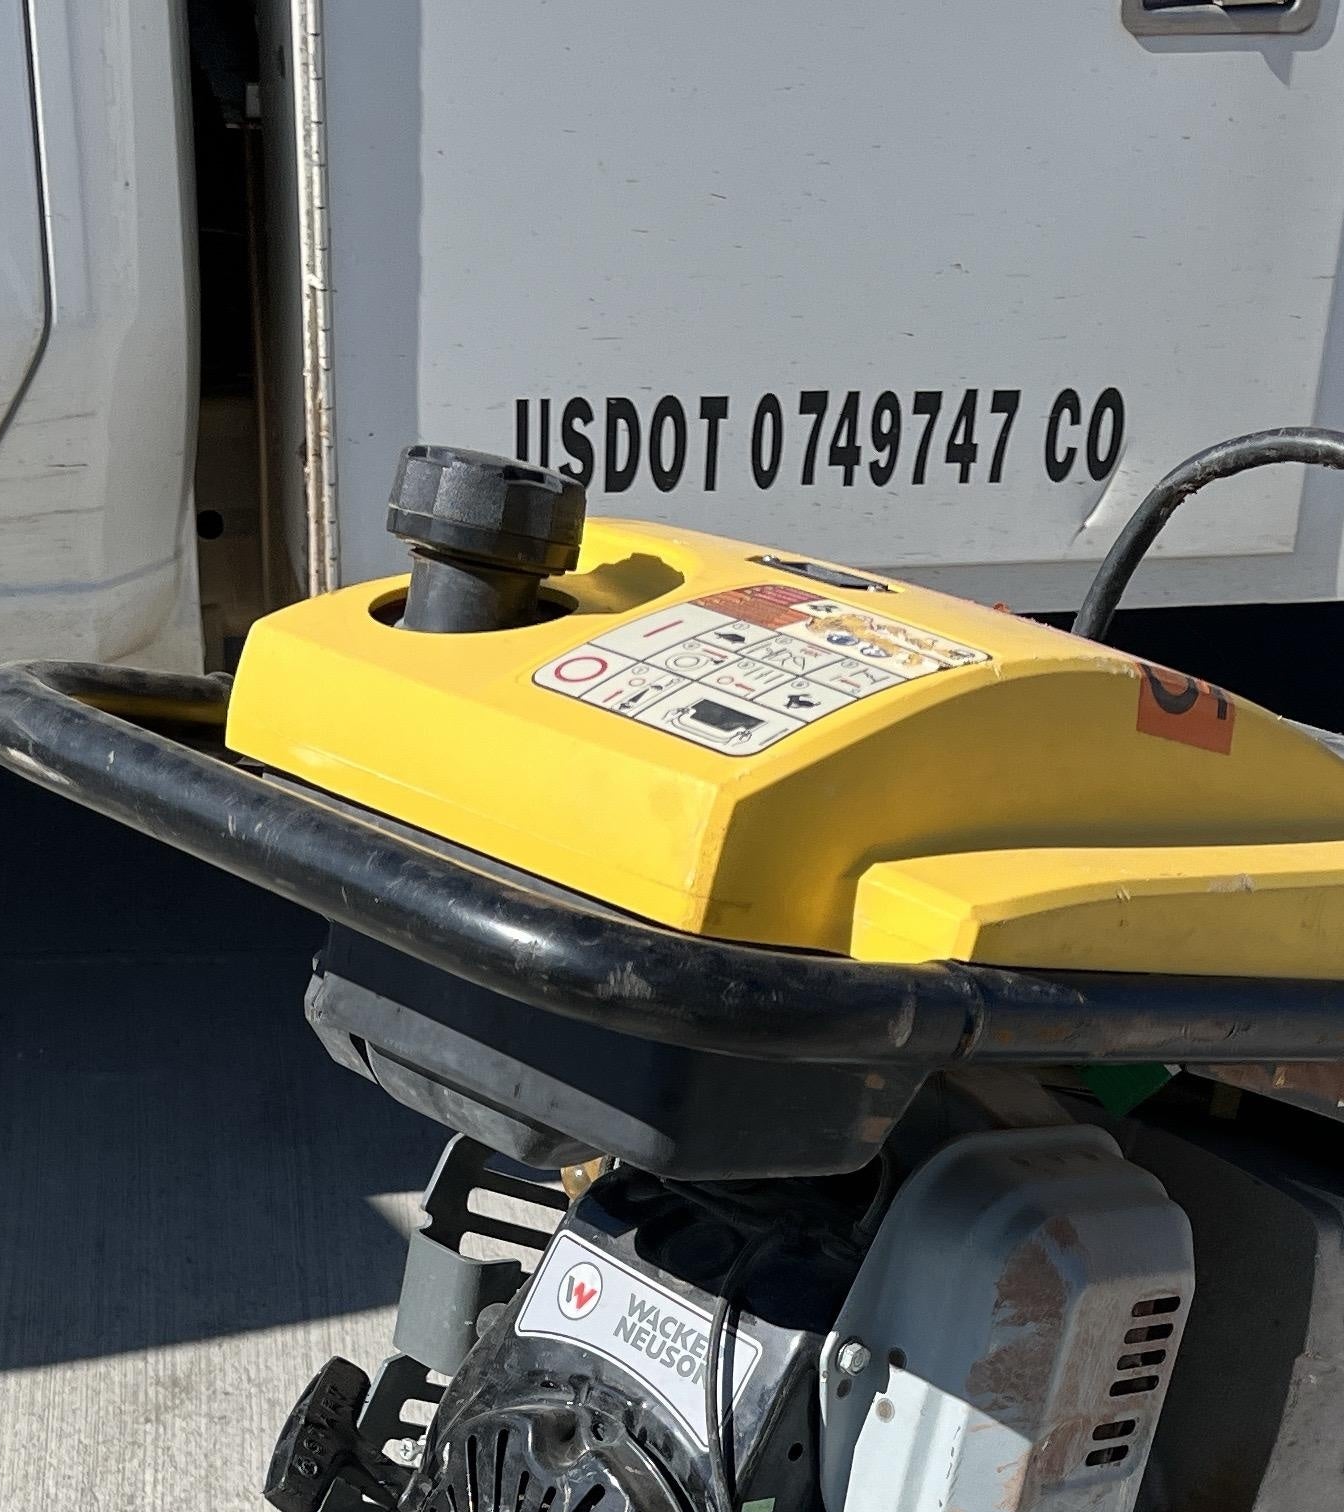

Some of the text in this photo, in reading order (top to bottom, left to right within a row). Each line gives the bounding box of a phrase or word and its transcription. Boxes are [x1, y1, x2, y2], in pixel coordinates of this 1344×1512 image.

[516, 387, 1125, 493] USDOT 0749747 CO
[628, 1292, 710, 1361] WACKE
